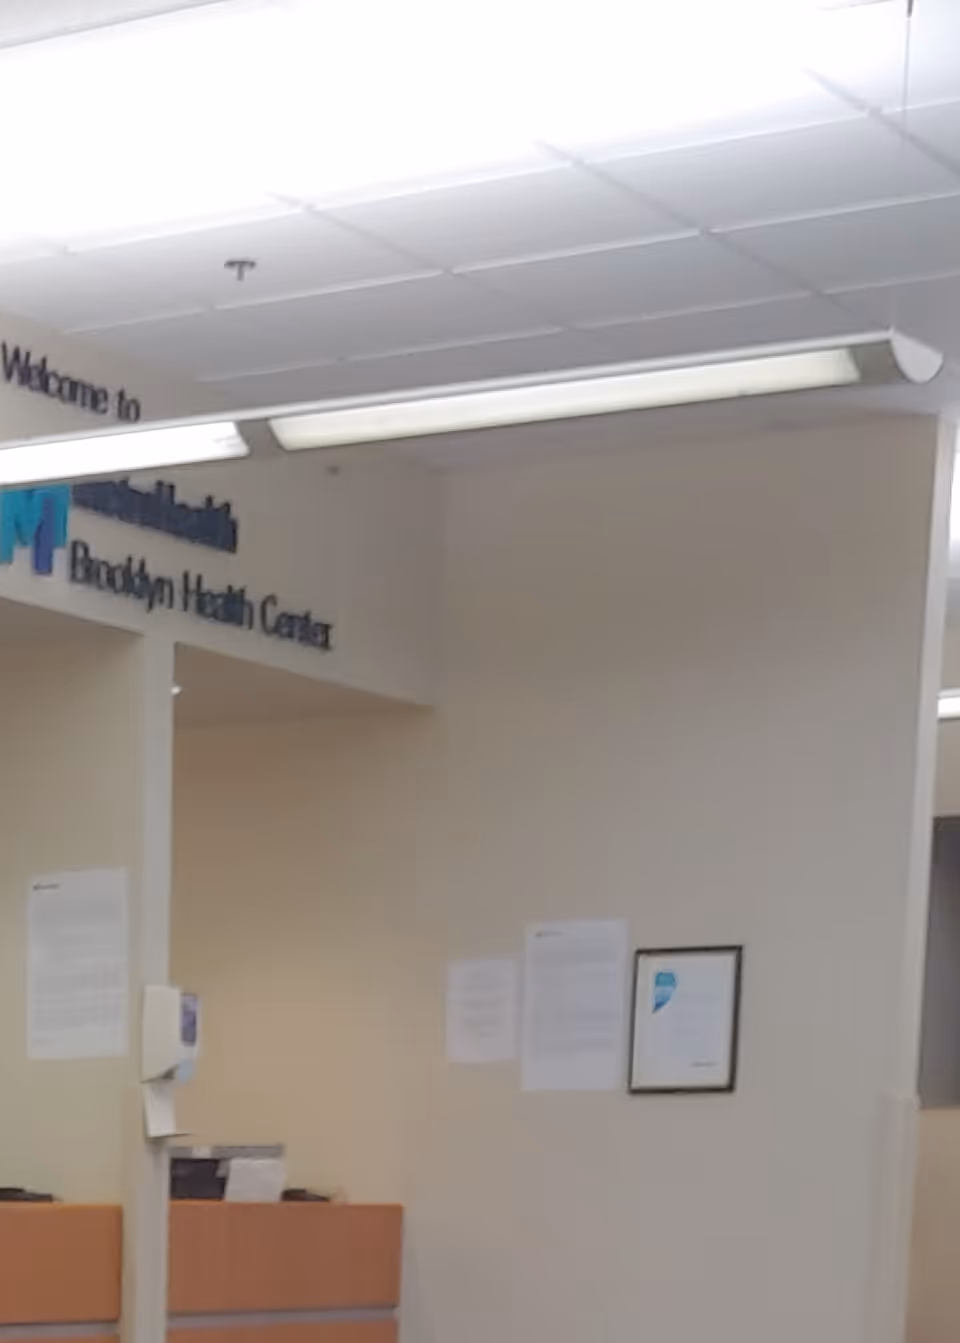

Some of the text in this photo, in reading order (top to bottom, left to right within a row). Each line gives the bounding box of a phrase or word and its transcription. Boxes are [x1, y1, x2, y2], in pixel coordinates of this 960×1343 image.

[1, 341, 141, 422] Welcome to
[71, 539, 333, 651] Brooklyn Health Center
